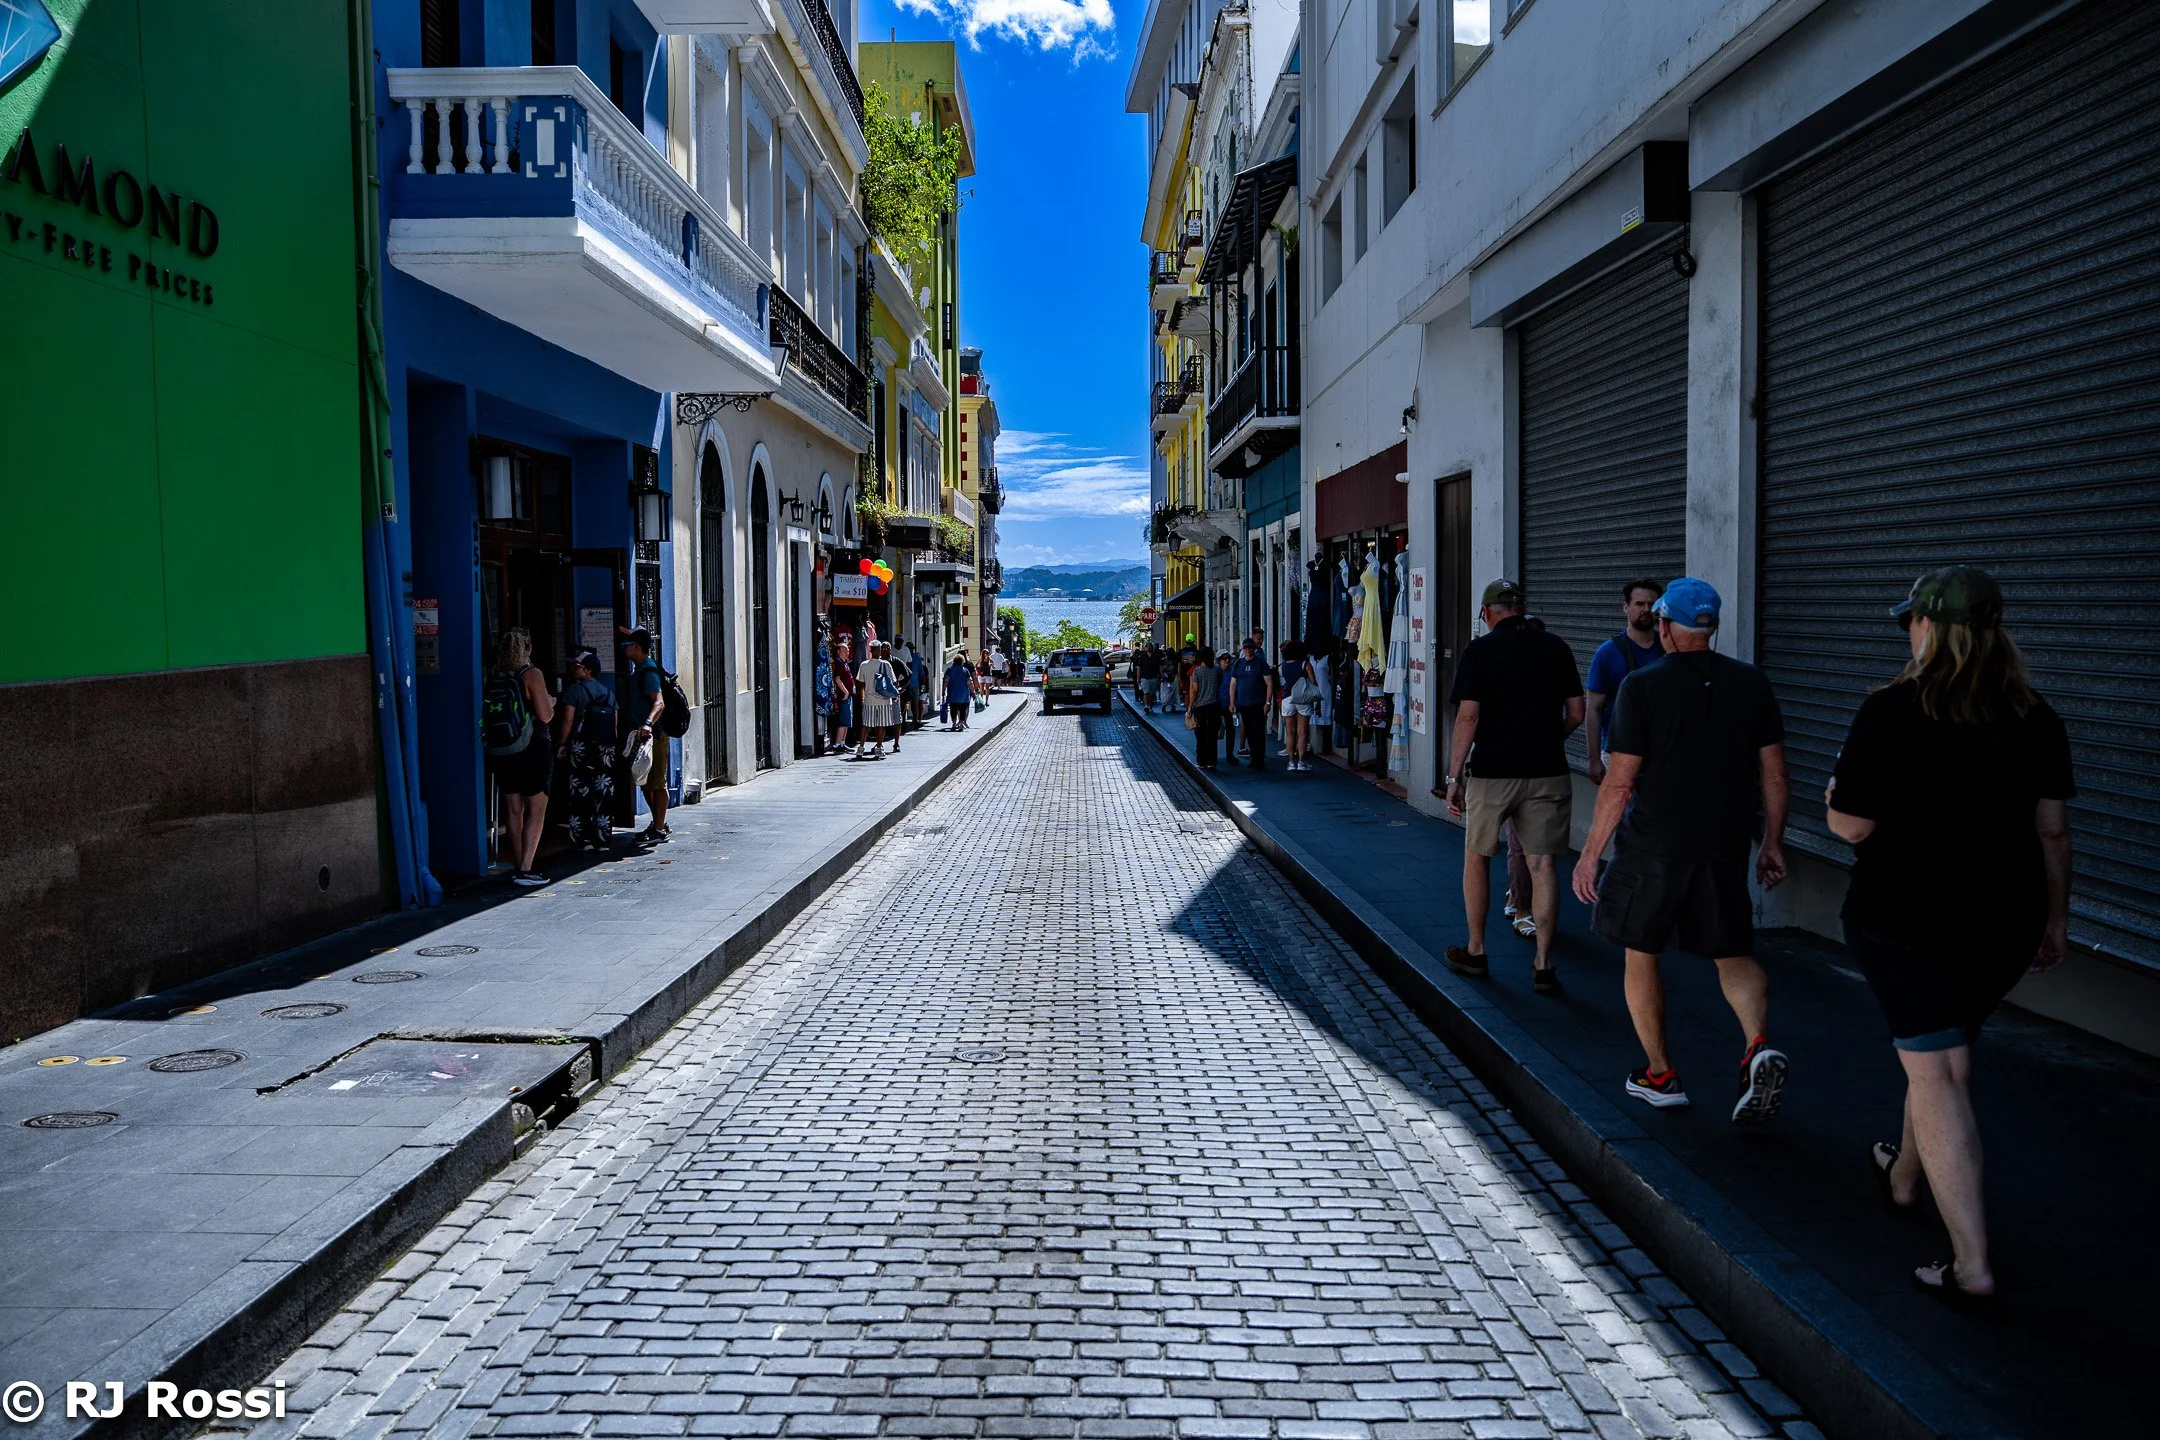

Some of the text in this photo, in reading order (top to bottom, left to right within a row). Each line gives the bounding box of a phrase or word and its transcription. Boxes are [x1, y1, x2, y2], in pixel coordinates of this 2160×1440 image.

[4, 126, 220, 257] AMOND
[128, 253, 215, 306] PRICES
[834, 586, 840, 595] 3
[853, 587, 867, 596] $10
[840, 576, 863, 584] T-SHIRTS
